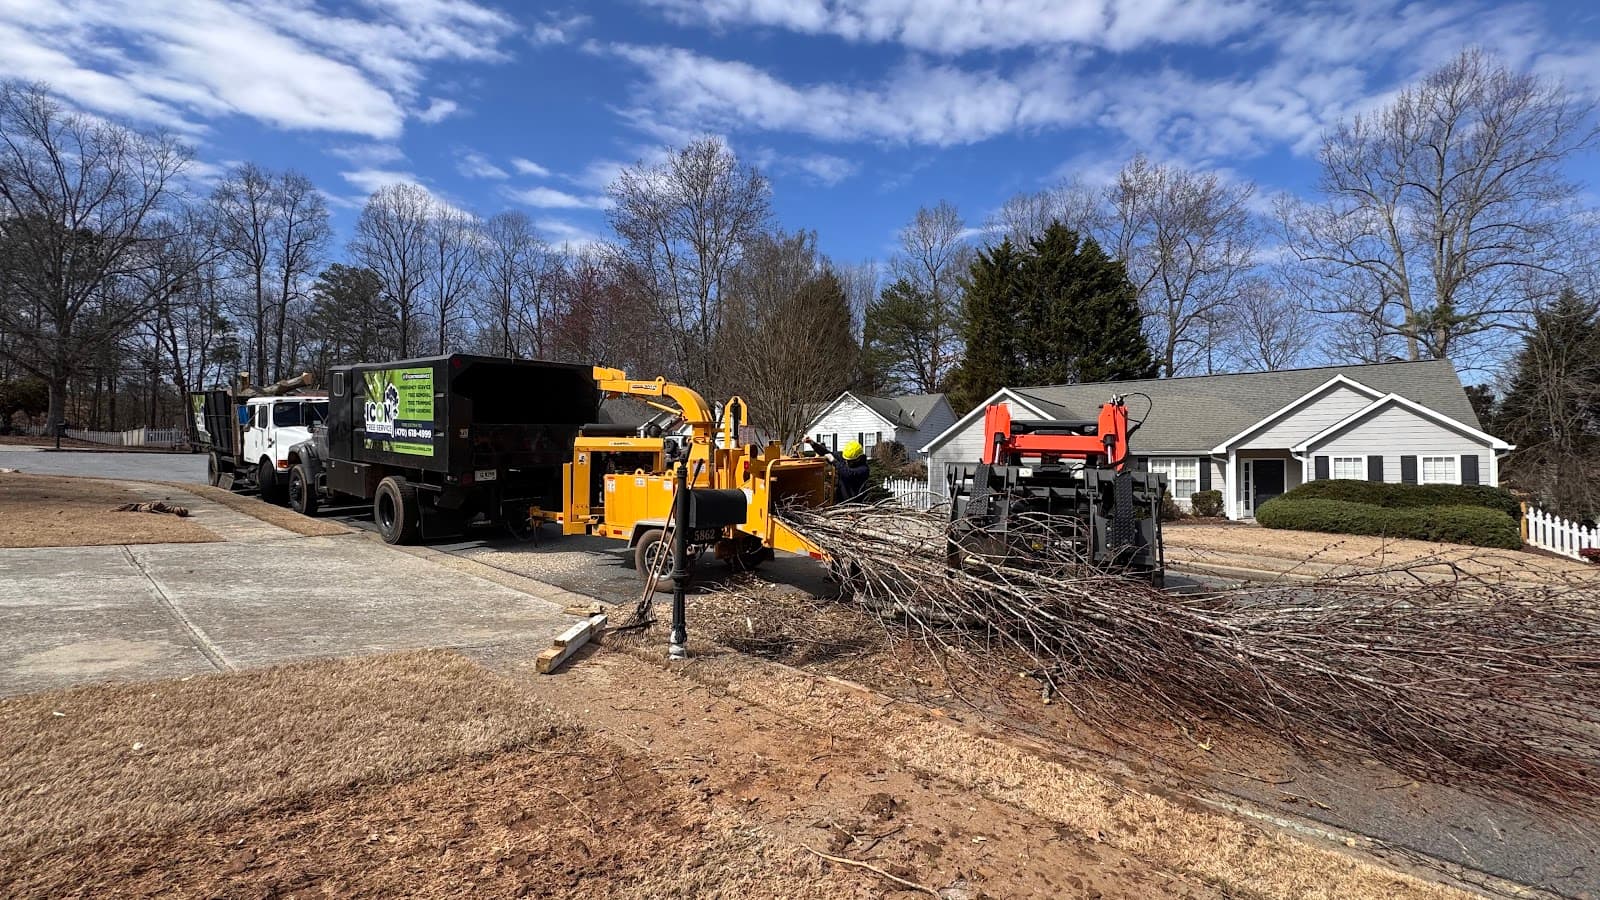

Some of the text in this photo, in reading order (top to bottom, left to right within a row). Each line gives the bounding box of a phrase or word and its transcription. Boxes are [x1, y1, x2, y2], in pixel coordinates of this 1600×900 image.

[366, 403, 392, 423] ICON
[366, 423, 376, 431] TREE
[376, 424, 392, 432] SERVICE
[395, 428, 407, 438] (470)
[694, 529, 715, 541] 5862
